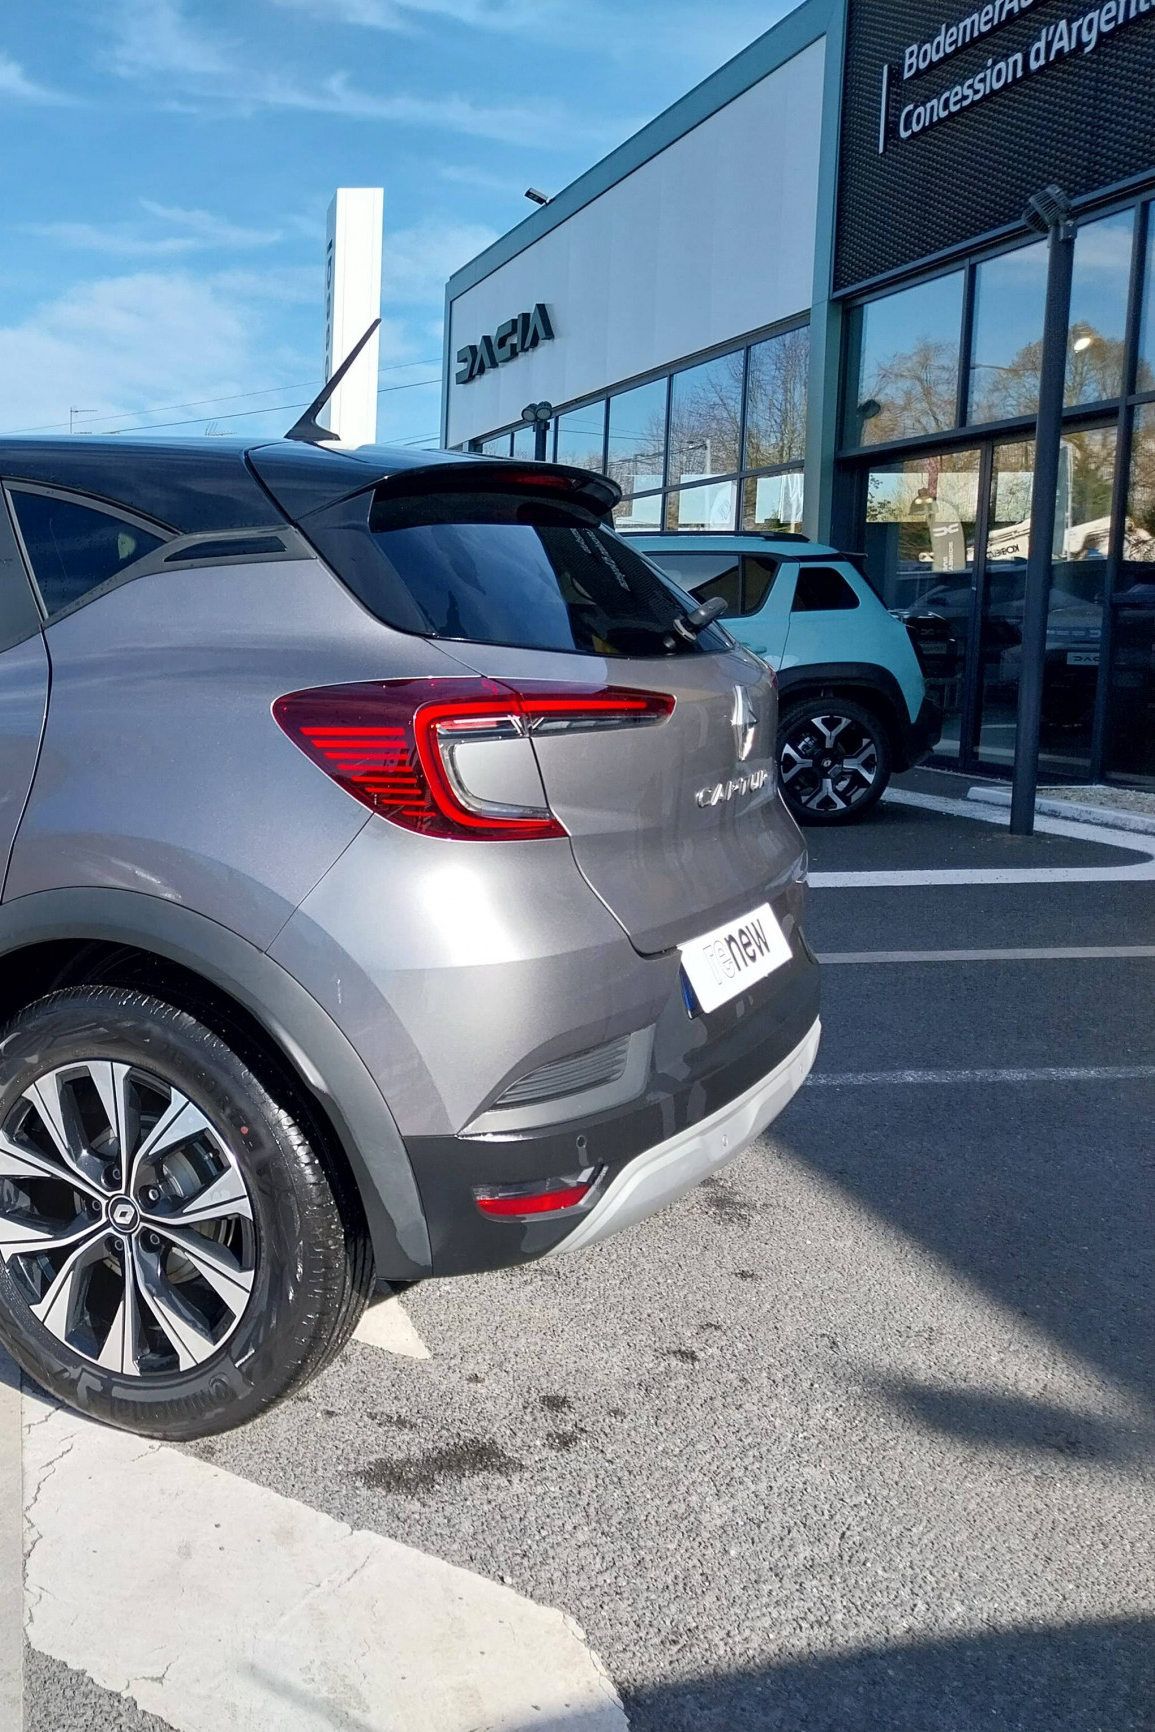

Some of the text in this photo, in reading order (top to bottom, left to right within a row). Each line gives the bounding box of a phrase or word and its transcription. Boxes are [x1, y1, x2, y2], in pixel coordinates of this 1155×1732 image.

[899, 0, 1155, 139] Concession d'Argen
[455, 303, 554, 384] DACIA
[702, 918, 770, 986] renew
